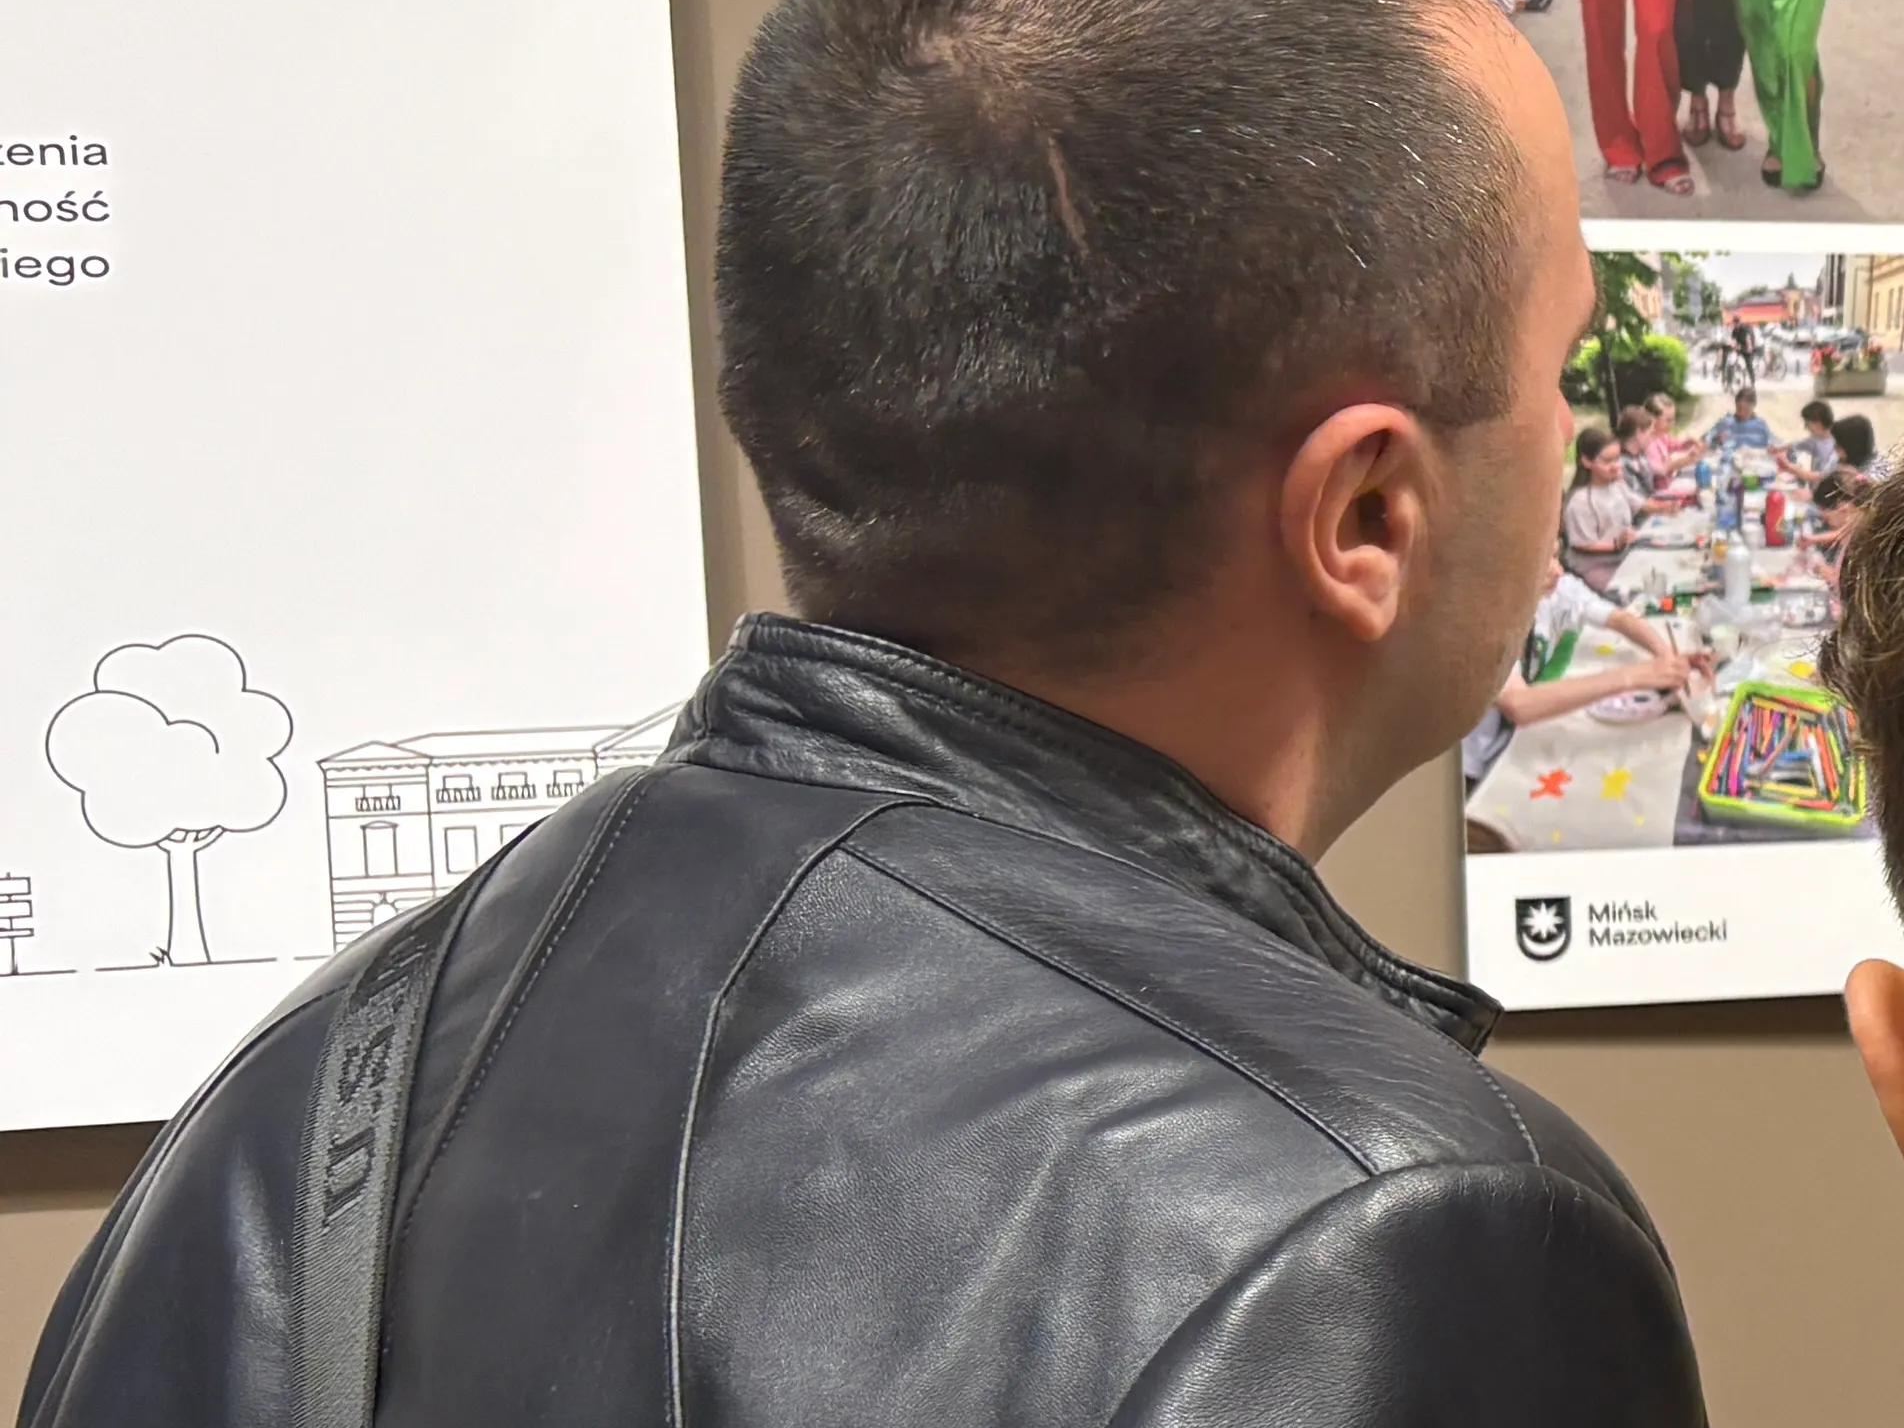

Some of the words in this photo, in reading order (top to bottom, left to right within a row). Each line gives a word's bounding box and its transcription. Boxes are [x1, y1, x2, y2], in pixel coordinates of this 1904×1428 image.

[0, 135, 108, 166] enia
[1588, 900, 1658, 923] Mińsk
[1589, 918, 1728, 946] Mazowiecki
